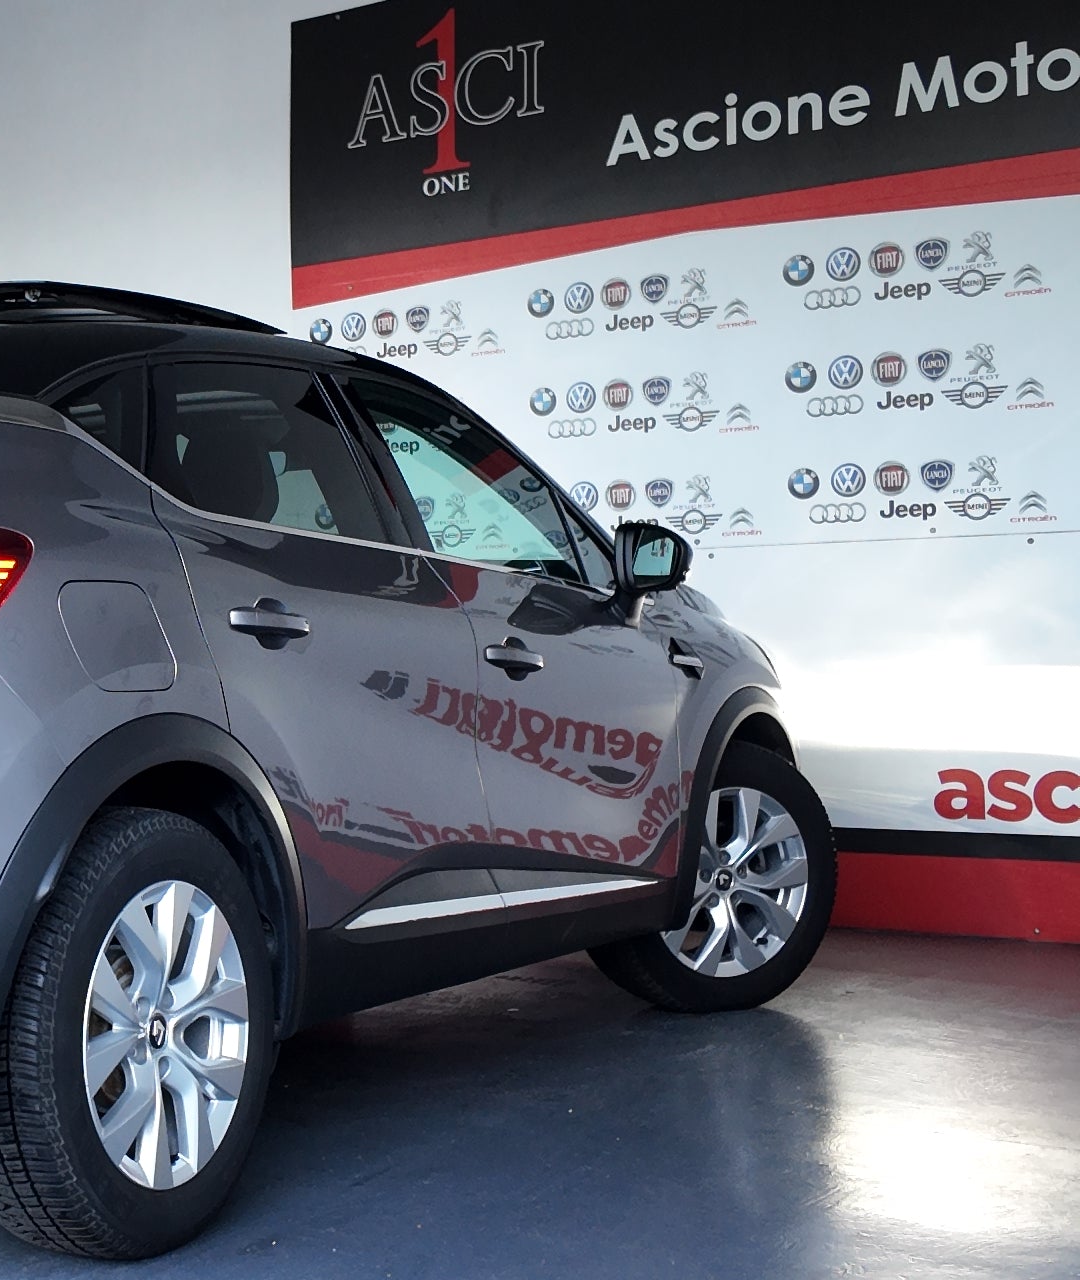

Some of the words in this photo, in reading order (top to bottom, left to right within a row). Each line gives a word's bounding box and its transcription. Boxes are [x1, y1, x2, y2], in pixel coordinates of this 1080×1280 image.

[347, 40, 545, 149] ASCI
[606, 85, 871, 167] Ascione
[895, 40, 1080, 117] Moto
[422, 172, 470, 197] ONE
[876, 251, 897, 269] FIAT
[947, 261, 998, 272] PEUGEOT
[874, 281, 931, 301] Jeep
[961, 279, 983, 288] MINI
[607, 286, 625, 303] FIAT
[605, 314, 654, 332] Jeep
[376, 342, 418, 359] Jeep
[879, 361, 900, 379] FIAT
[923, 359, 945, 370] LANCIA
[949, 373, 1000, 384] PEUGEOT
[609, 387, 628, 404] FIAT
[876, 390, 934, 411] Jeep
[964, 391, 985, 400] MINI
[607, 415, 656, 433] Jeep
[882, 470, 904, 489] FIAT
[926, 469, 947, 480] LANCIA
[611, 488, 631, 504] FIAT
[952, 485, 1003, 495] PEUGEOT
[879, 499, 937, 521] Jeep
[967, 502, 987, 511] MINI
[934, 768, 1080, 824] asc
